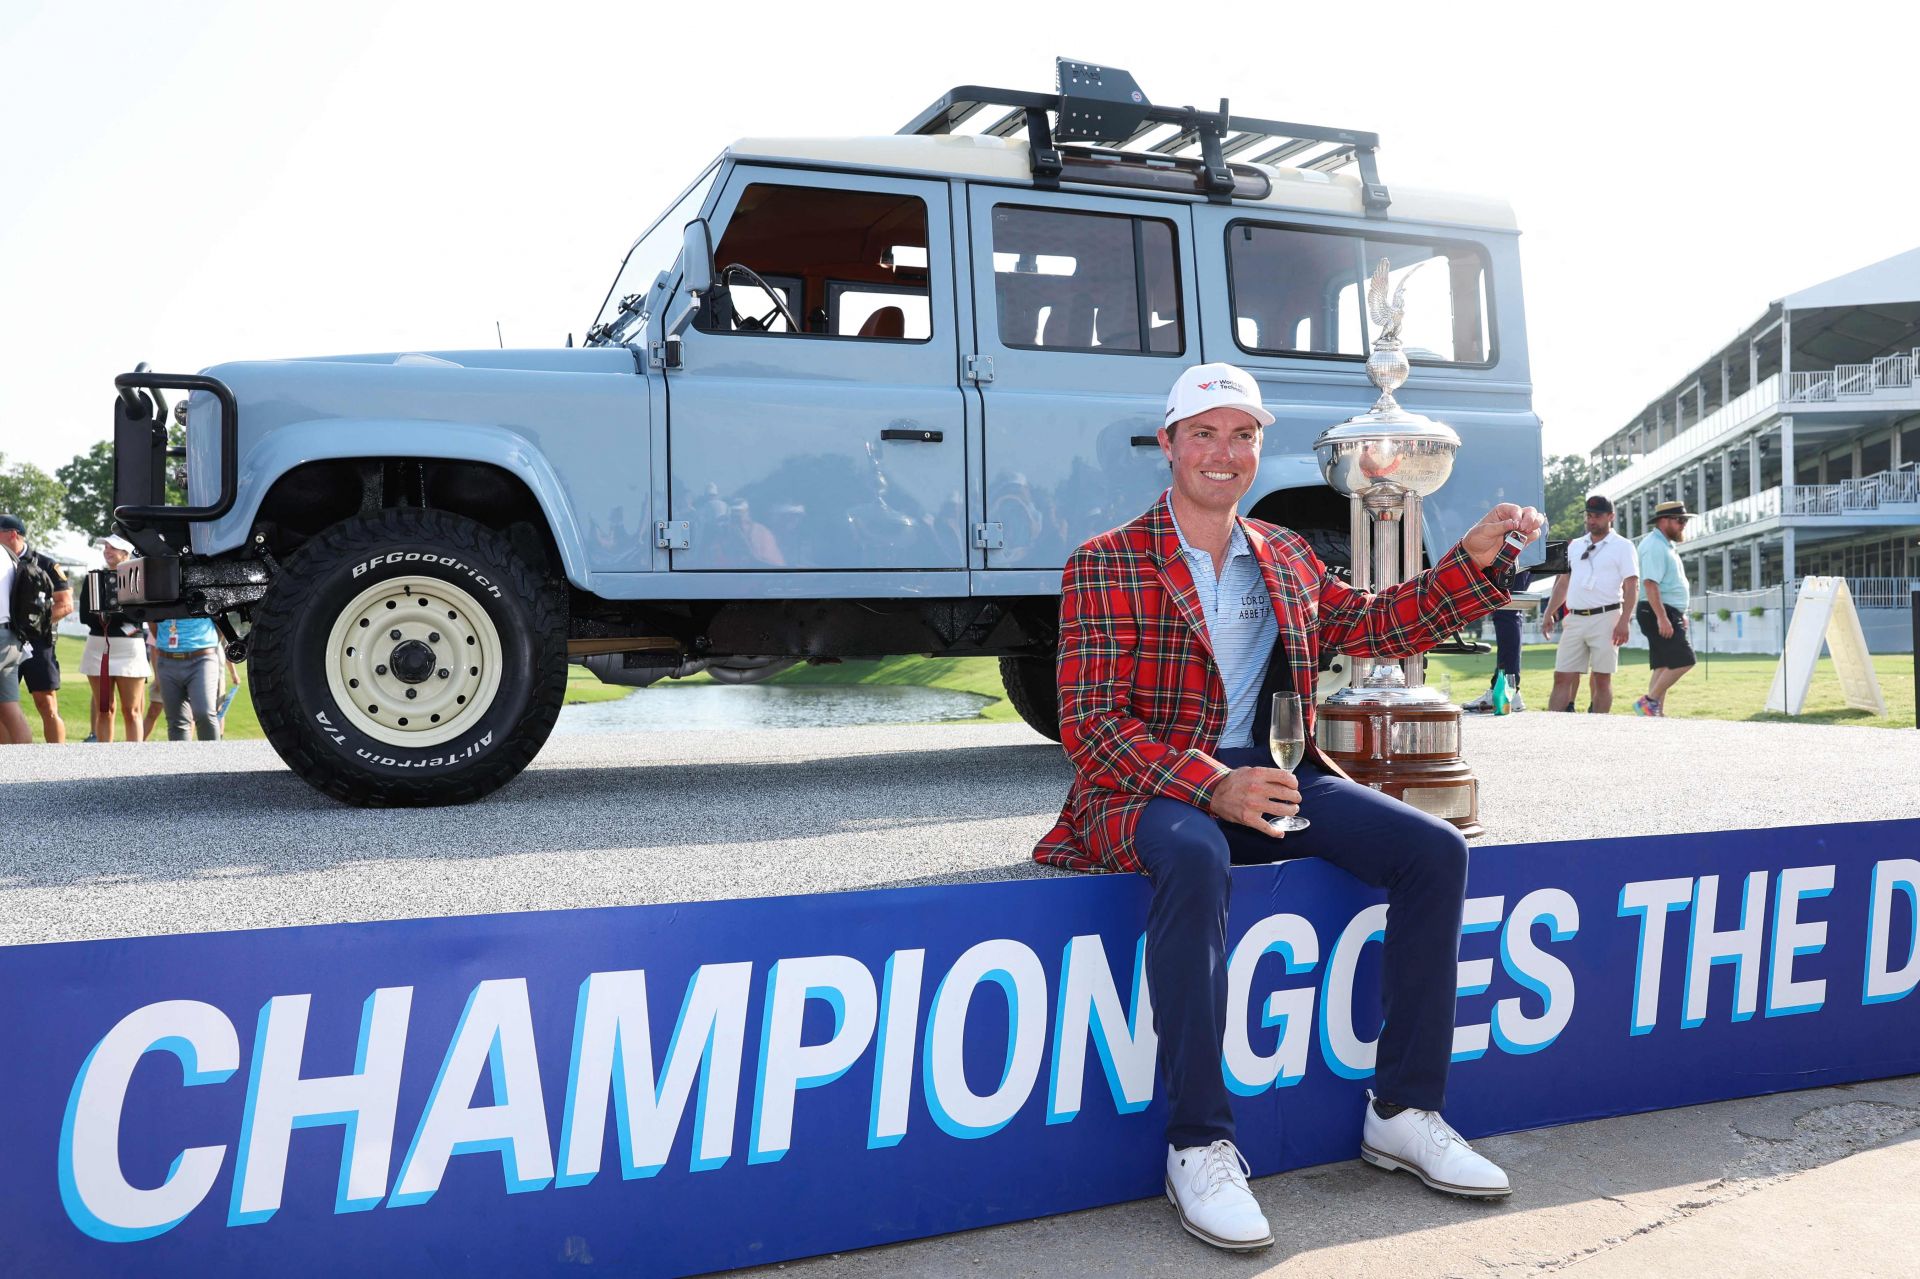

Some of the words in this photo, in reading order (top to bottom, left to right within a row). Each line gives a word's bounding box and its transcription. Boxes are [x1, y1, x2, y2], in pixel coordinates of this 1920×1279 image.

[352, 551, 502, 599] BFGoodrich
[1239, 607, 1270, 619] ABBETT
[1241, 595, 1265, 606] LORD
[316, 711, 347, 746] T/A
[356, 730, 493, 768] All-Terrain
[58, 932, 1158, 1242] CHAMPION
[1617, 865, 1836, 1036] THE
